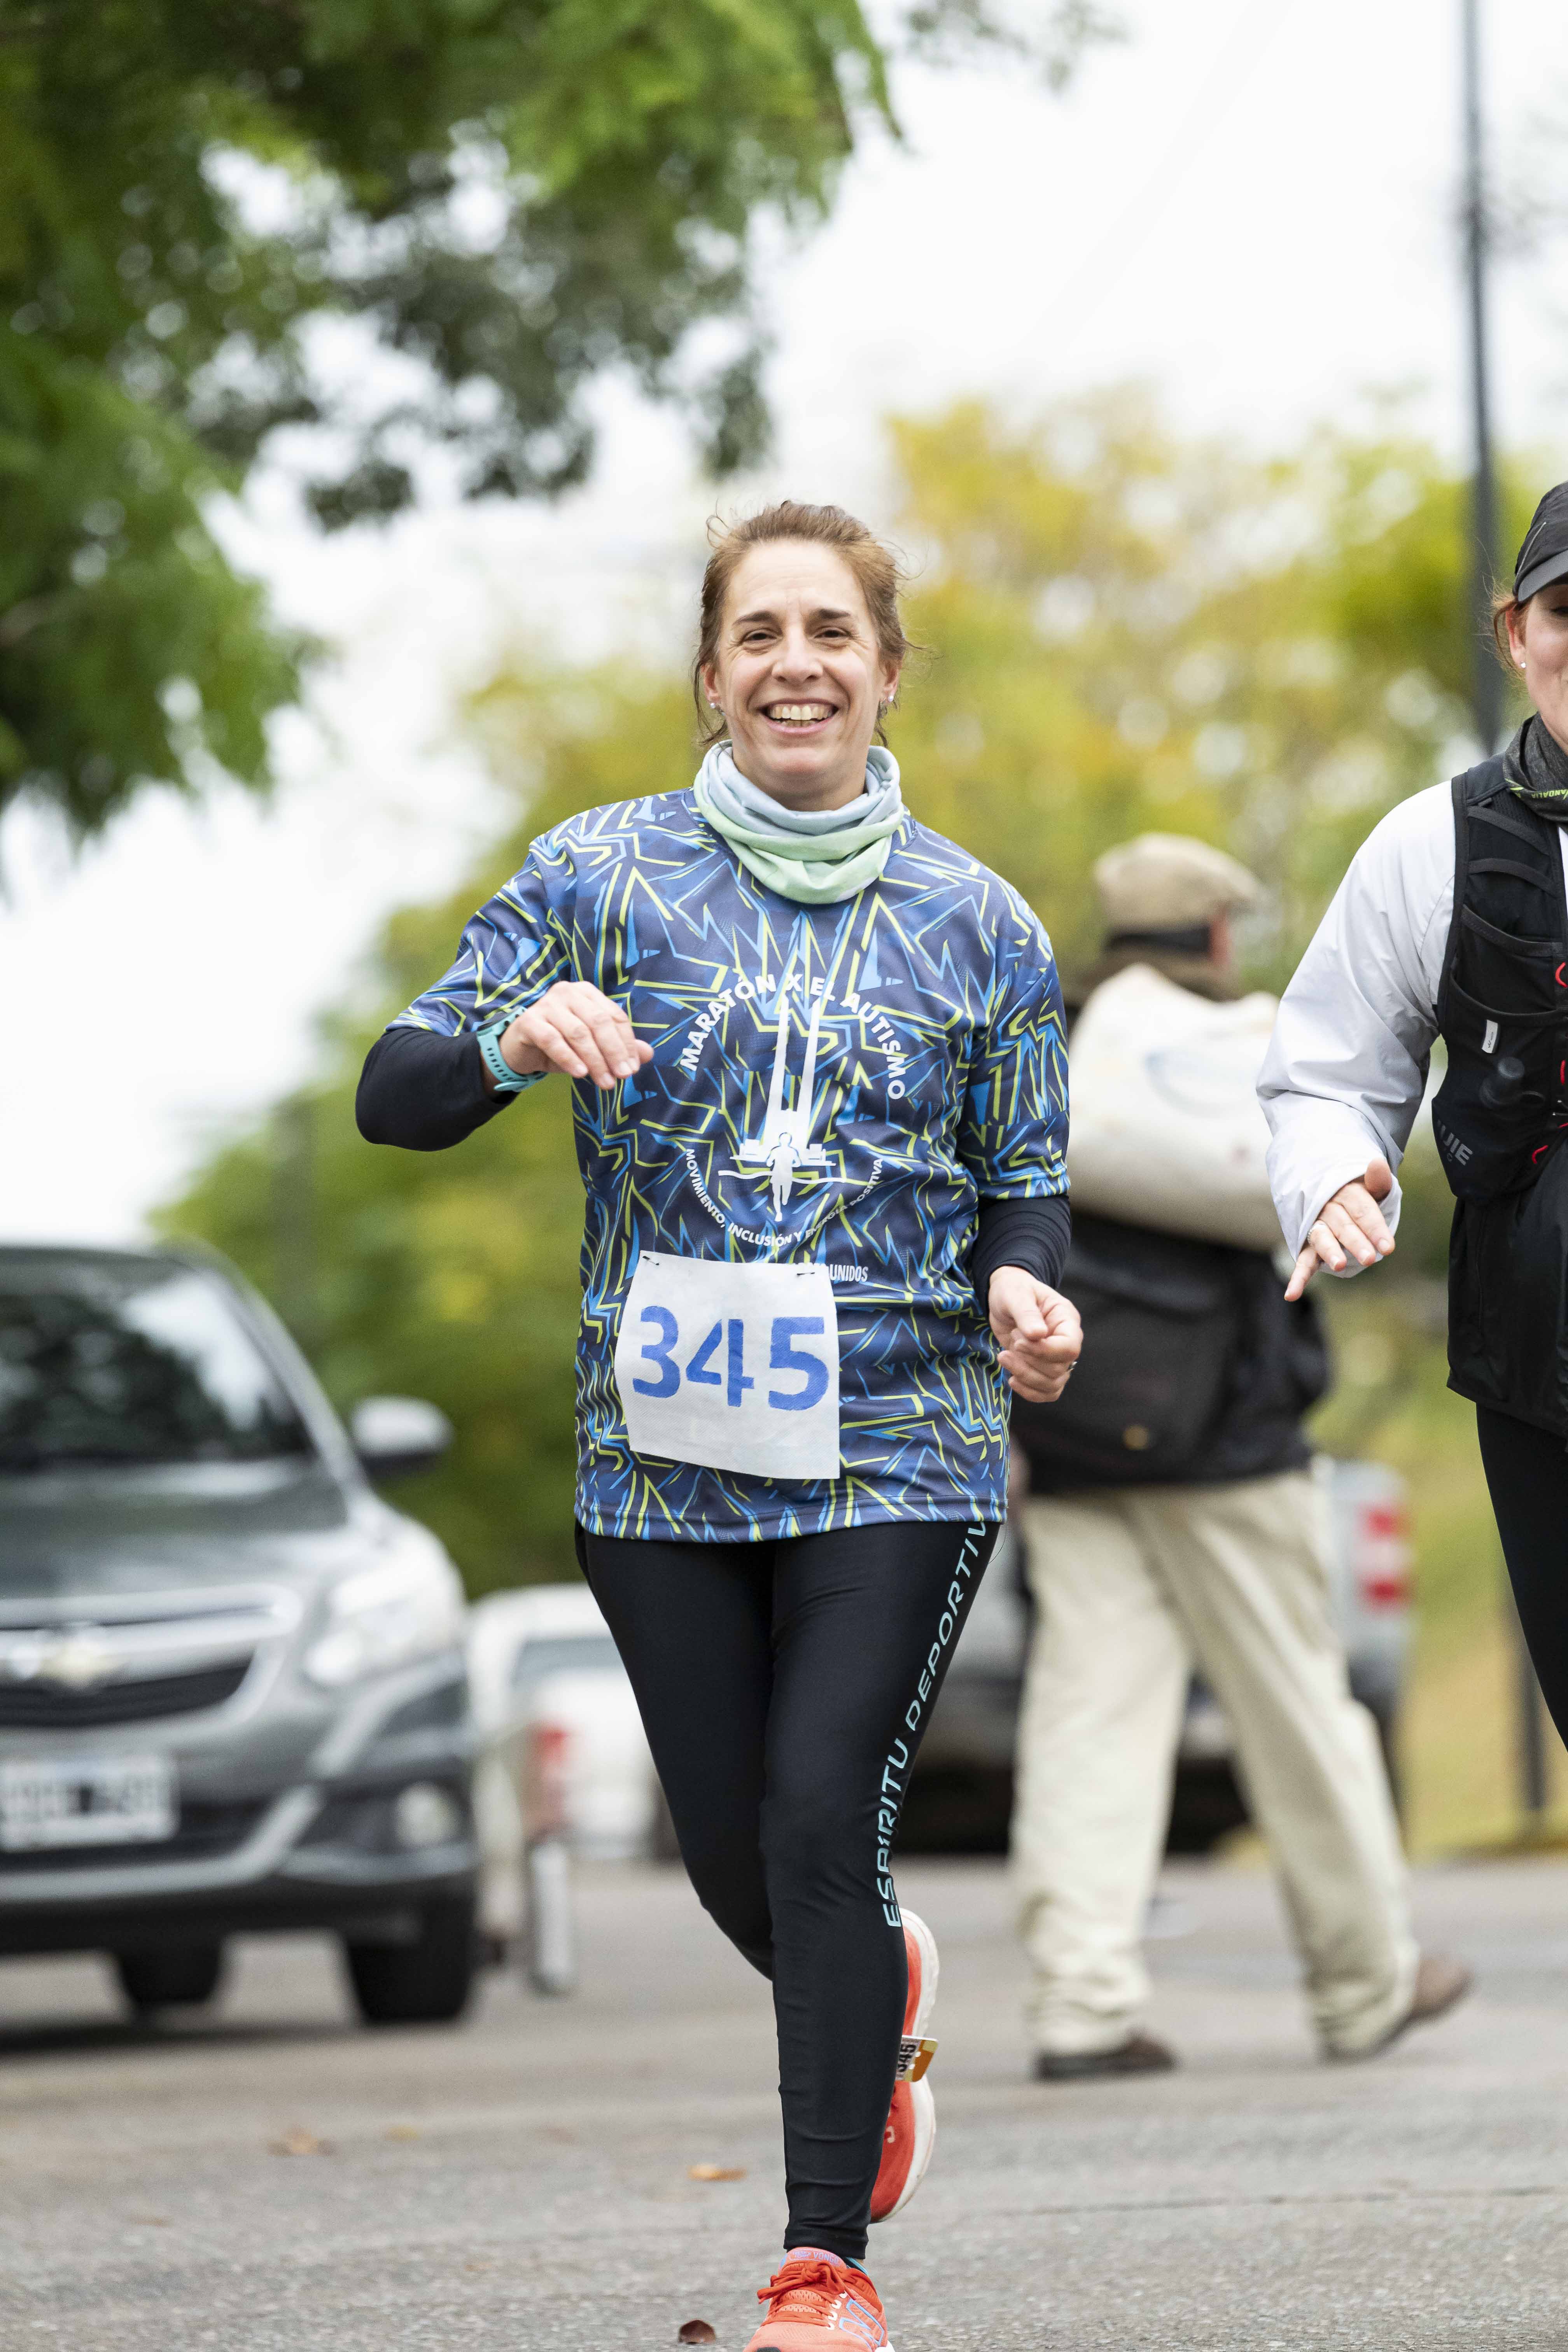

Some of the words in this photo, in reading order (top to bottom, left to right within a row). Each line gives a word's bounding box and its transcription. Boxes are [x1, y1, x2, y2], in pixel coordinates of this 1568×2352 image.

[680, 973, 777, 1071] MARATÓN
[786, 973, 803, 992] X
[810, 976, 836, 1001] EL
[840, 992, 906, 1100] AUTISMO
[686, 1148, 726, 1228] MOVIMIENTO,
[727, 1222, 792, 1248] INCLUSIÓN
[793, 1231, 803, 1242] Y
[849, 1158, 884, 1206] POSITIVA
[829, 1264, 869, 1283] UNIDOS
[632, 1305, 830, 1411] 345
